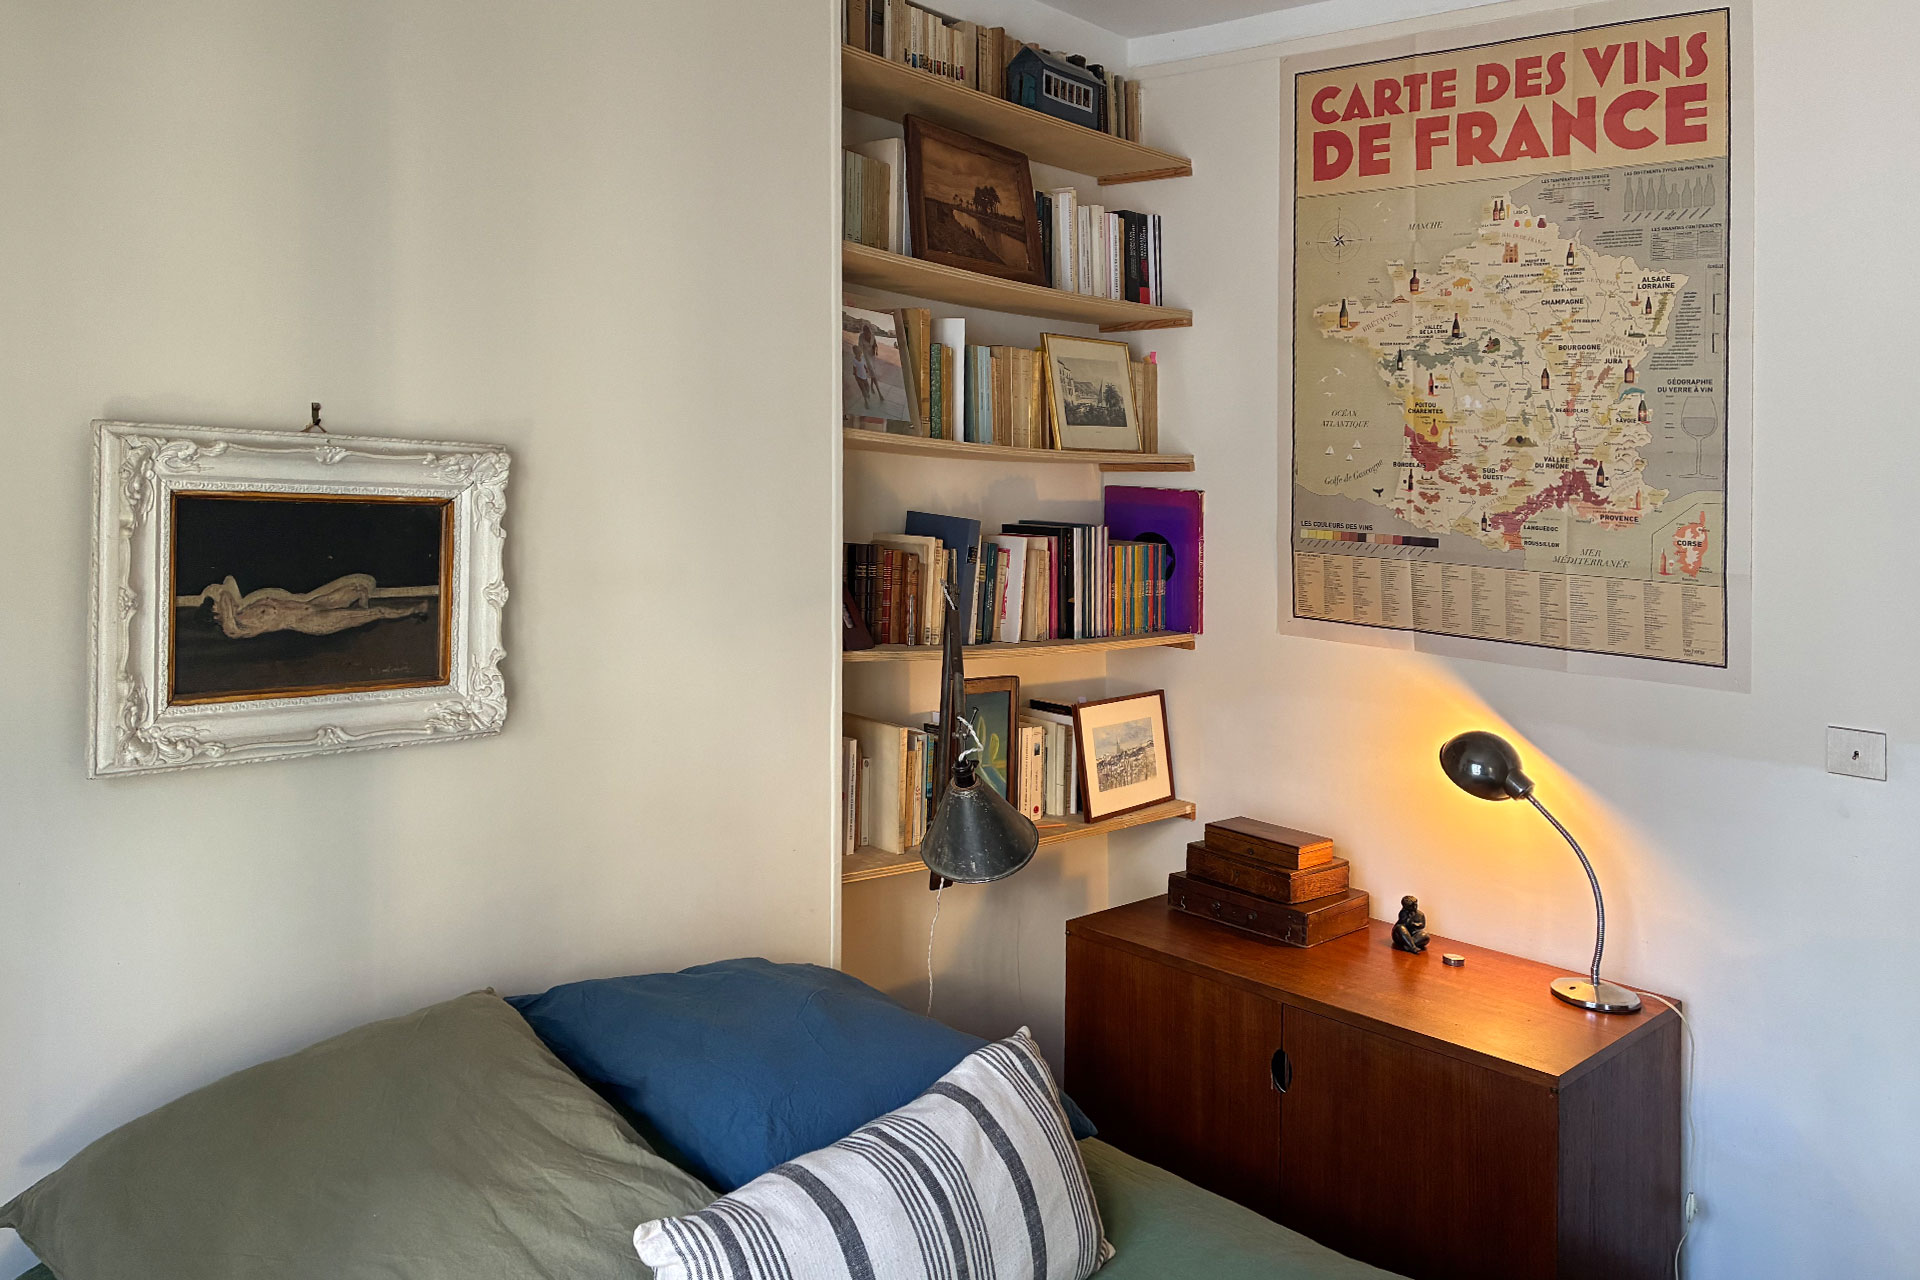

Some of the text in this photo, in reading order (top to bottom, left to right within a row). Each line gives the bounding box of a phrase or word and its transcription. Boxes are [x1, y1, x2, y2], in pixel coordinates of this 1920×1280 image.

[1311, 31, 1708, 125] CARTE DES VINS
[1313, 83, 1708, 182] DE FRANCE
[1408, 220, 1443, 232] MANCHE
[1642, 275, 1671, 283] ALSACE
[1637, 282, 1675, 290] LORRAINE
[1541, 298, 1584, 306] CHAMPAGNE
[1361, 309, 1400, 334] BRETAGNE
[1667, 377, 1713, 386] GÉOGRAPHIE
[1331, 409, 1358, 418] OCÉAN
[1321, 420, 1370, 429] ATLANTIQUE
[1392, 461, 1426, 469] BORDELAIS
[1324, 474, 1343, 486] Golfe
[1343, 472, 1352, 483] de
[1600, 514, 1639, 523] PROVENCE
[1313, 521, 1345, 529] COULEURS
[1523, 540, 1560, 548] ROUSSILLON
[1677, 540, 1702, 548] CORSE
[1580, 548, 1602, 557] MER
[1552, 554, 1630, 569] MÉDITERRANÉE
